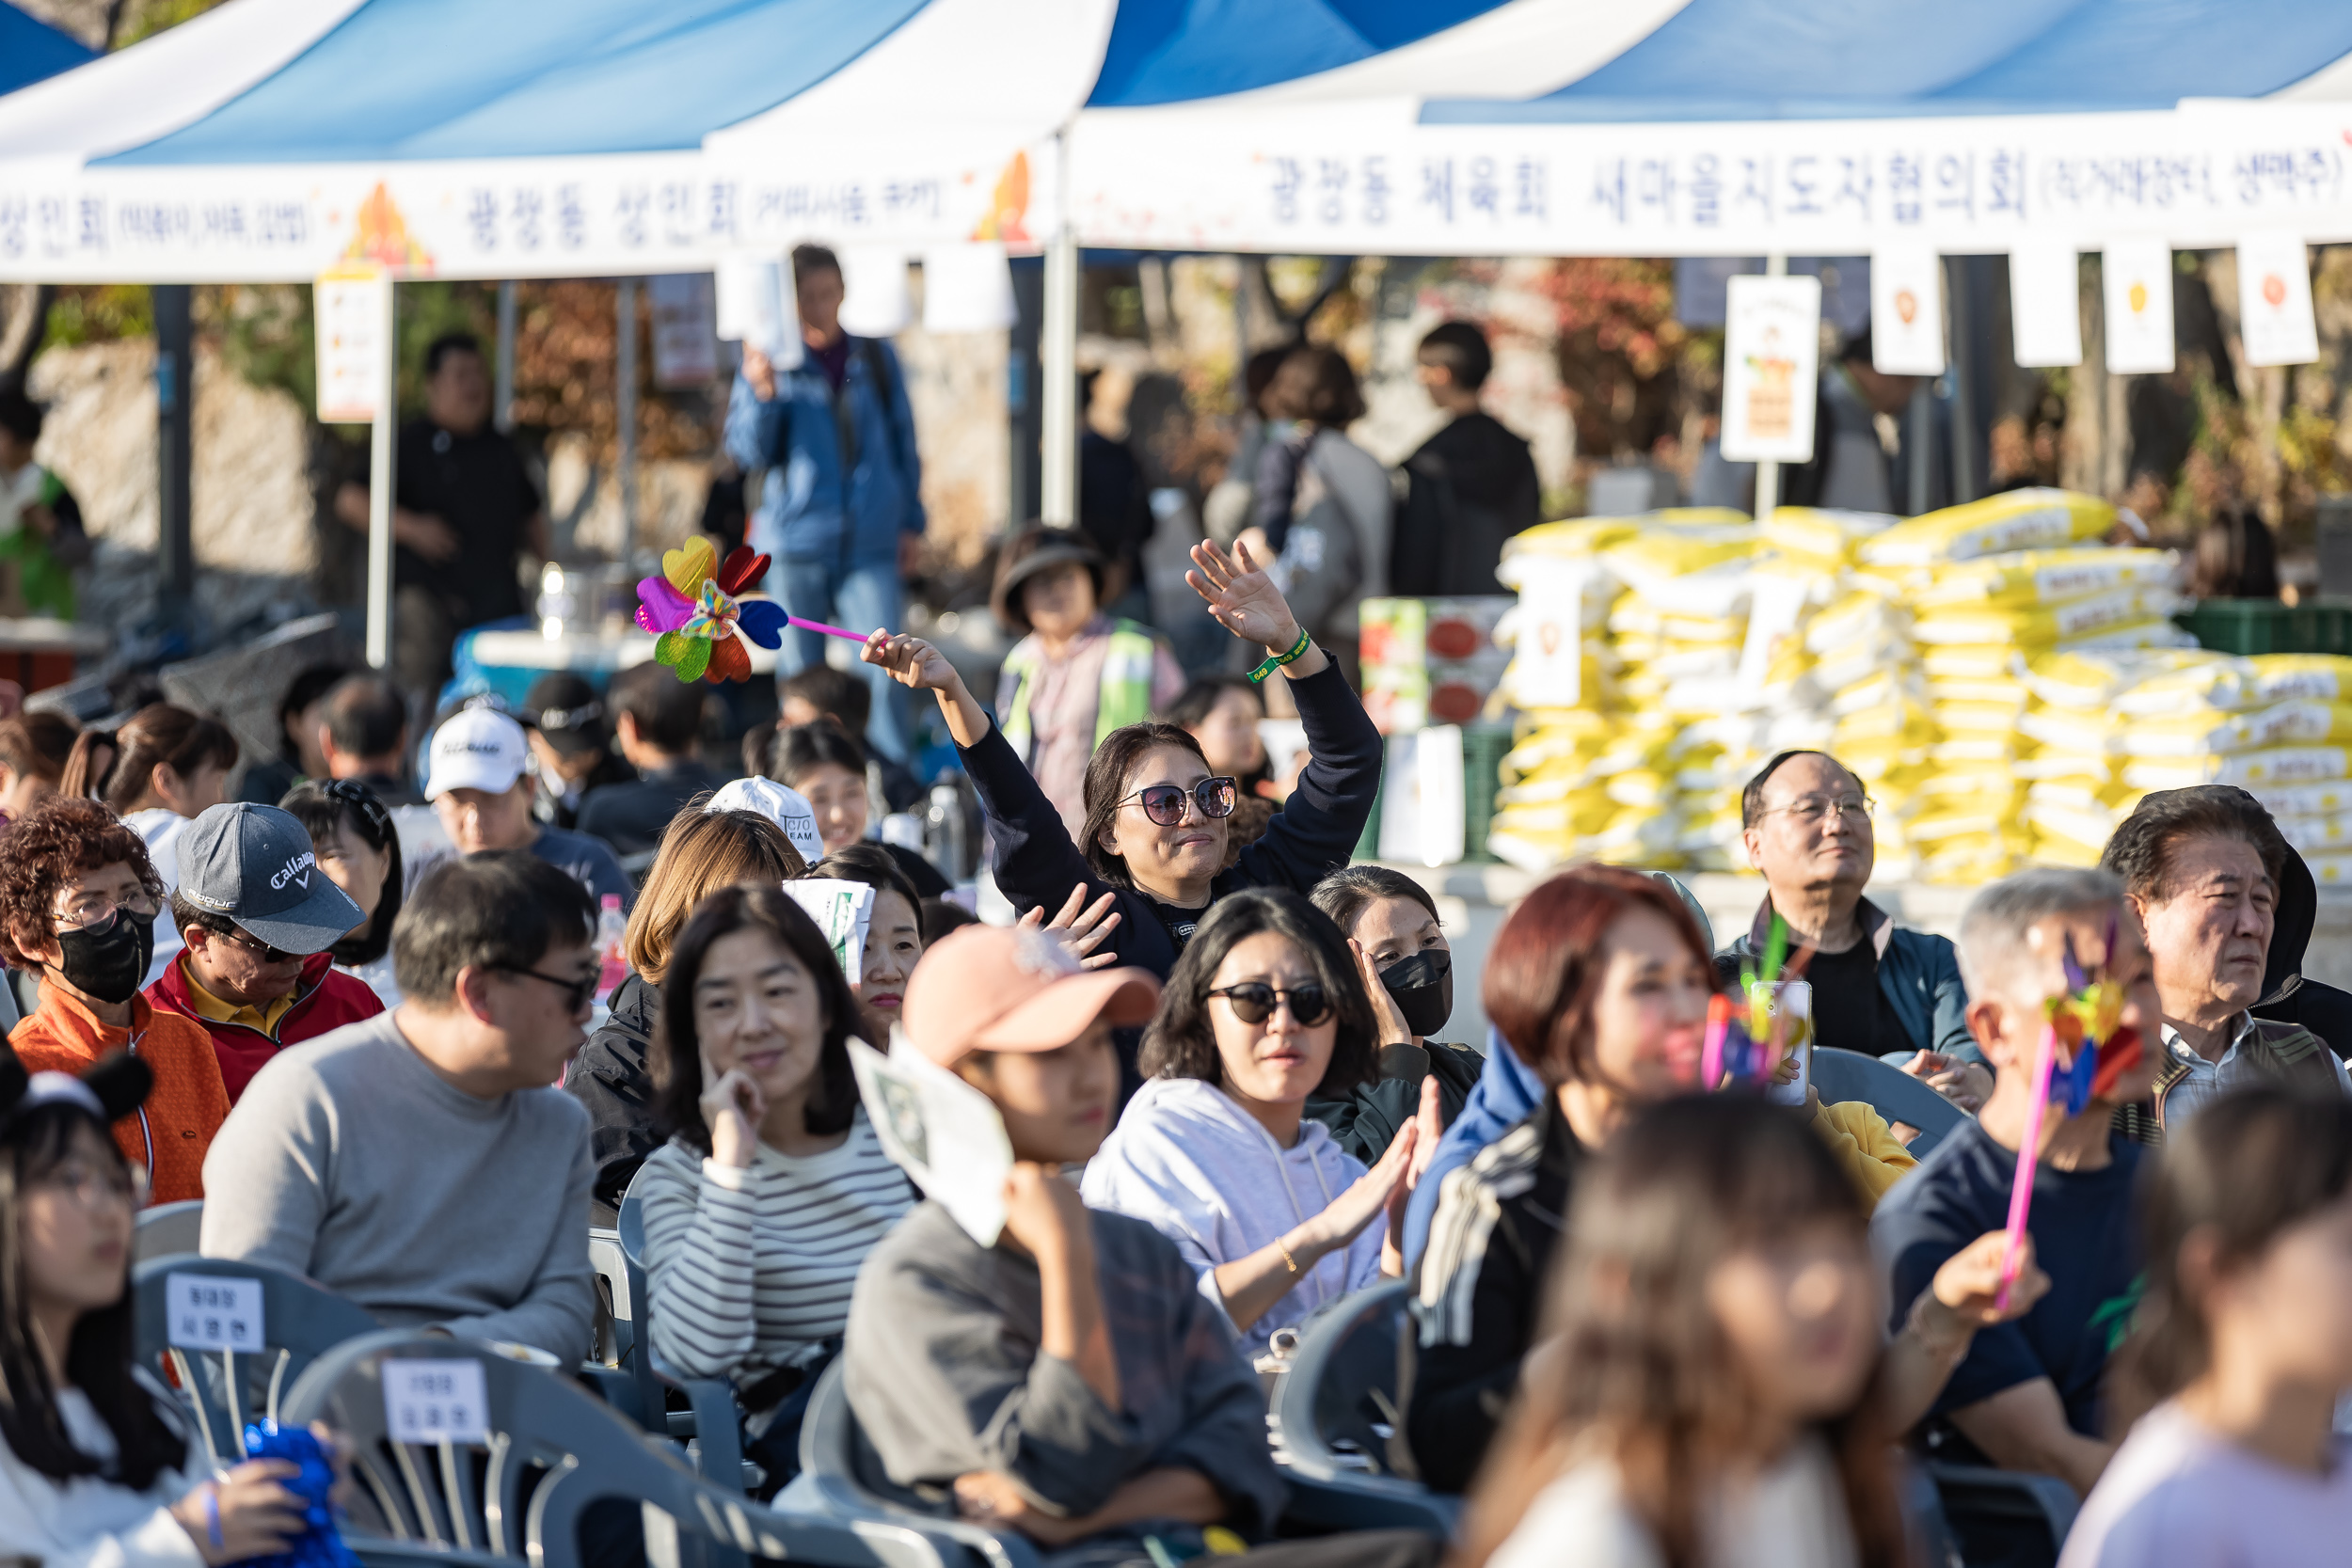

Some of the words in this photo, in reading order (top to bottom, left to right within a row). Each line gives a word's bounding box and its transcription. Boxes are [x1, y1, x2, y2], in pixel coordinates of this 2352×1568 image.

[1418, 151, 1550, 228] 체육회
[1587, 148, 2028, 227] 새마을지도자협의회
[270, 851, 315, 890] Callaway
